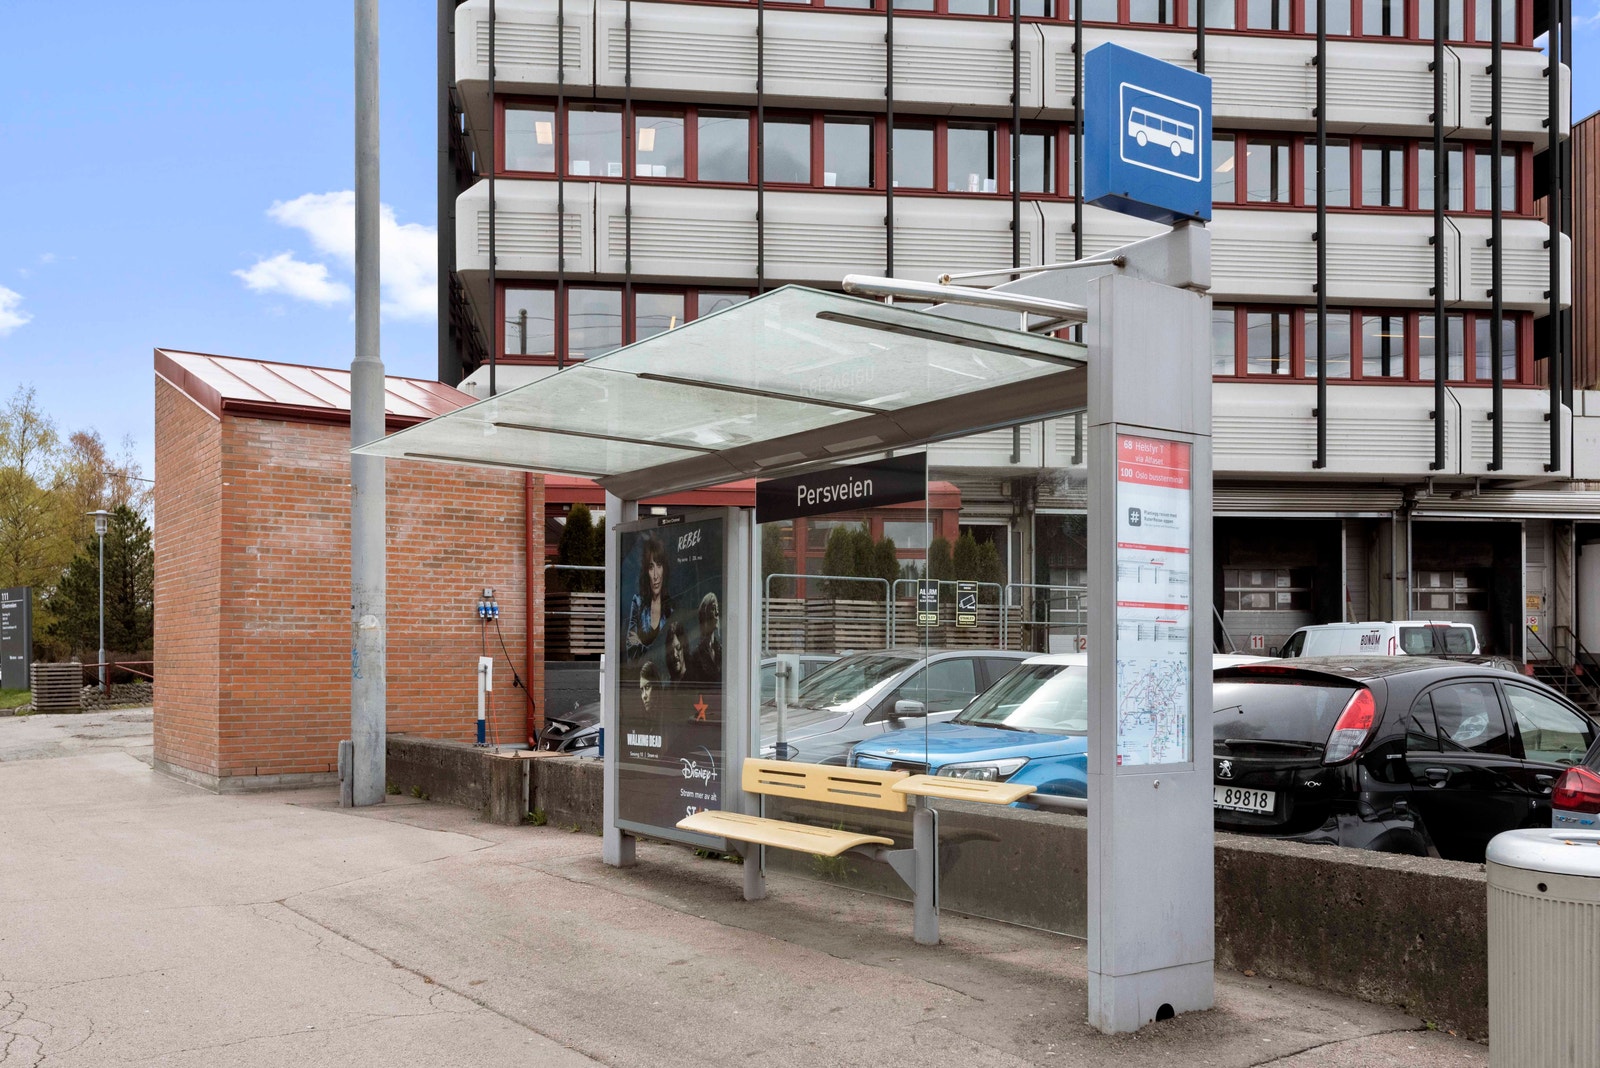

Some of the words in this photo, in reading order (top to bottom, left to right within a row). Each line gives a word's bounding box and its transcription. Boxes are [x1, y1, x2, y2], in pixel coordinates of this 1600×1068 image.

[1123, 440, 1133, 450] 68
[1135, 441, 1158, 455] Helsfyr
[1159, 445, 1165, 454] T
[1145, 456, 1164, 465] Alfaset
[1121, 468, 1133, 478] 100
[1135, 471, 1148, 480] Oslo
[1148, 473, 1184, 484] bussterminal
[797, 476, 873, 507] Persveien
[677, 528, 702, 553] REBEL
[919, 588, 937, 596] ALRM
[1252, 636, 1264, 648] 11
[1360, 634, 1381, 646] BONUM
[627, 733, 649, 747] WALKING
[649, 734, 662, 748] DEAD
[680, 757, 718, 787] Disney+
[680, 788, 694, 798] Strøm
[694, 792, 704, 800] mer
[1224, 788, 1268, 808] 89818
